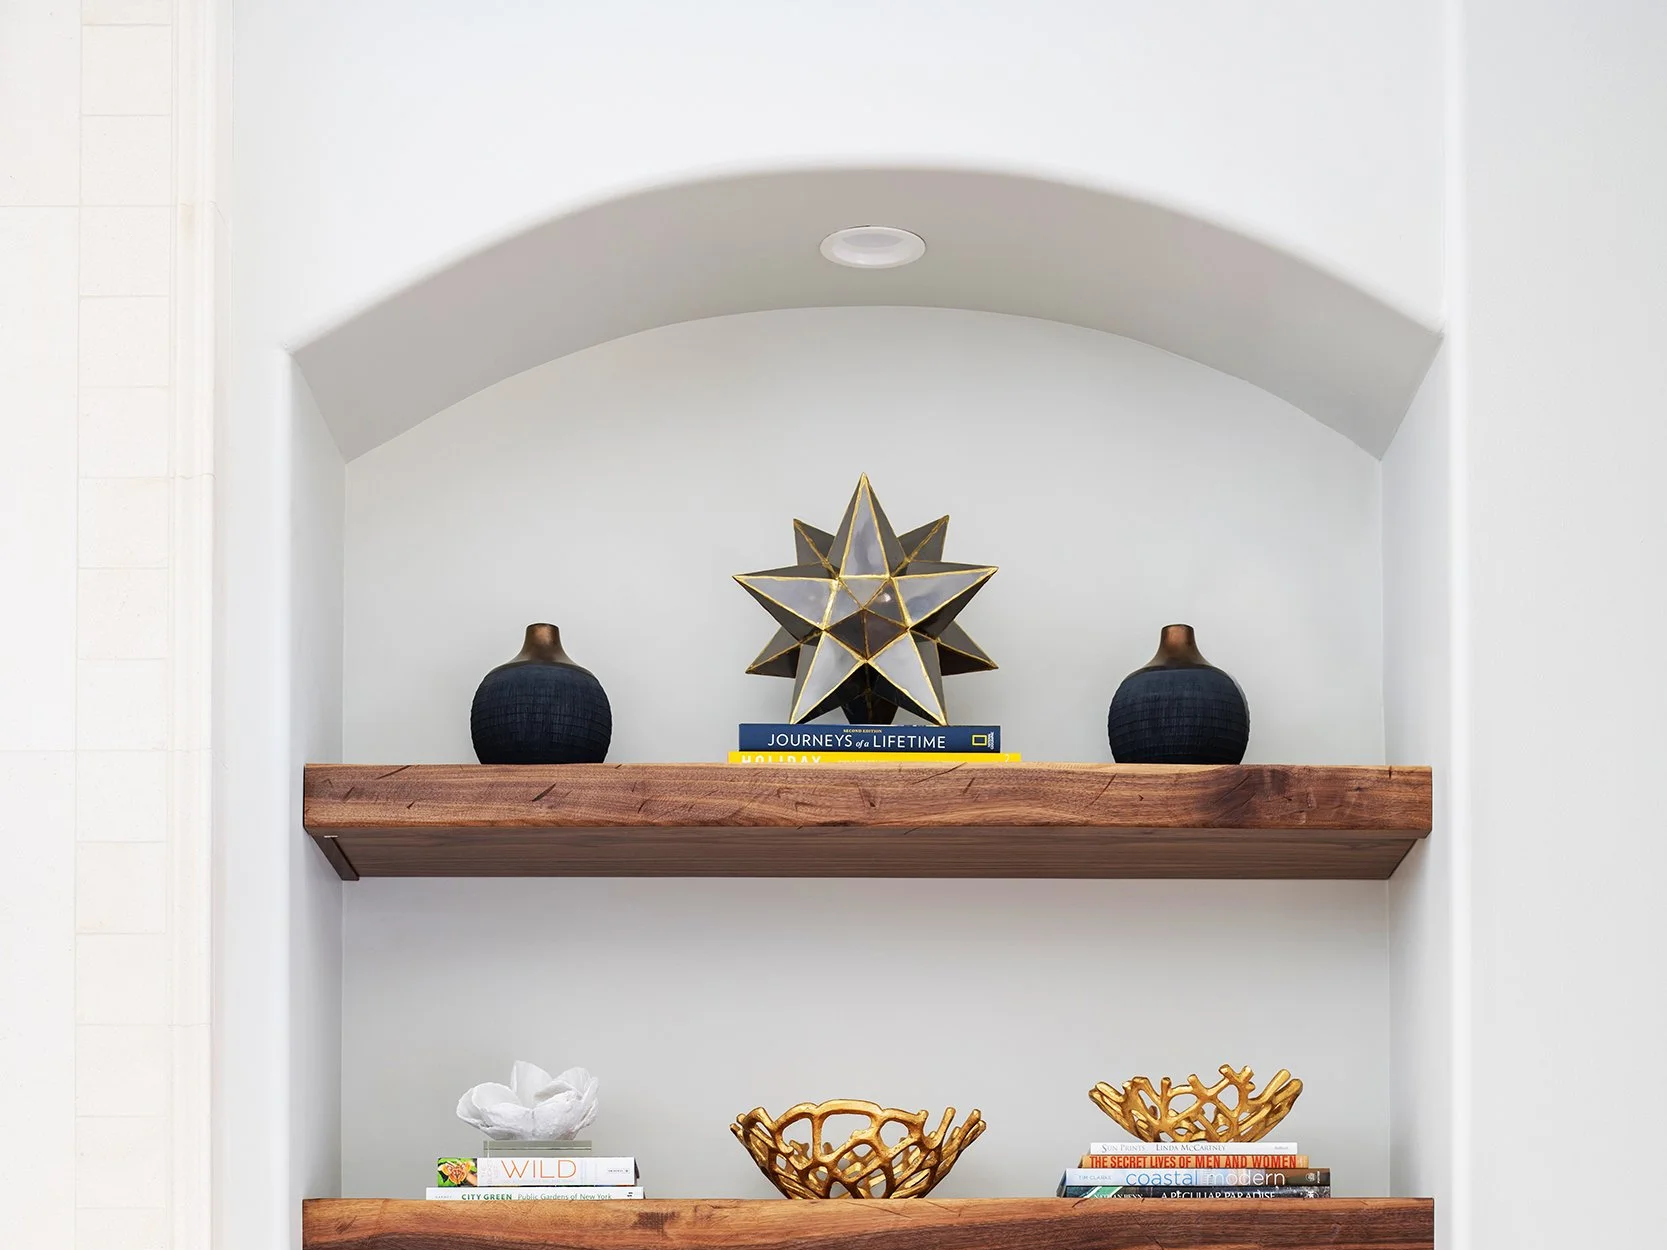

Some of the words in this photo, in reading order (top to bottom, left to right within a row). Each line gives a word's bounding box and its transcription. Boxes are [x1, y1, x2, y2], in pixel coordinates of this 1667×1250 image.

[767, 733, 853, 747] JOURNEYS
[873, 735, 946, 749] LIFETIME
[1156, 1143, 1179, 1152] LINDA
[501, 1159, 577, 1179] WILD
[1089, 1155, 1108, 1169] THE
[1110, 1155, 1148, 1169] SECRET
[1150, 1155, 1176, 1169] LIVES
[1178, 1155, 1192, 1169] OF
[1194, 1155, 1221, 1169] MEN
[1224, 1155, 1248, 1169] AND
[1251, 1155, 1297, 1169] WOMEN
[1125, 1170, 1198, 1186] coastal
[1206, 1169, 1285, 1186] modern
